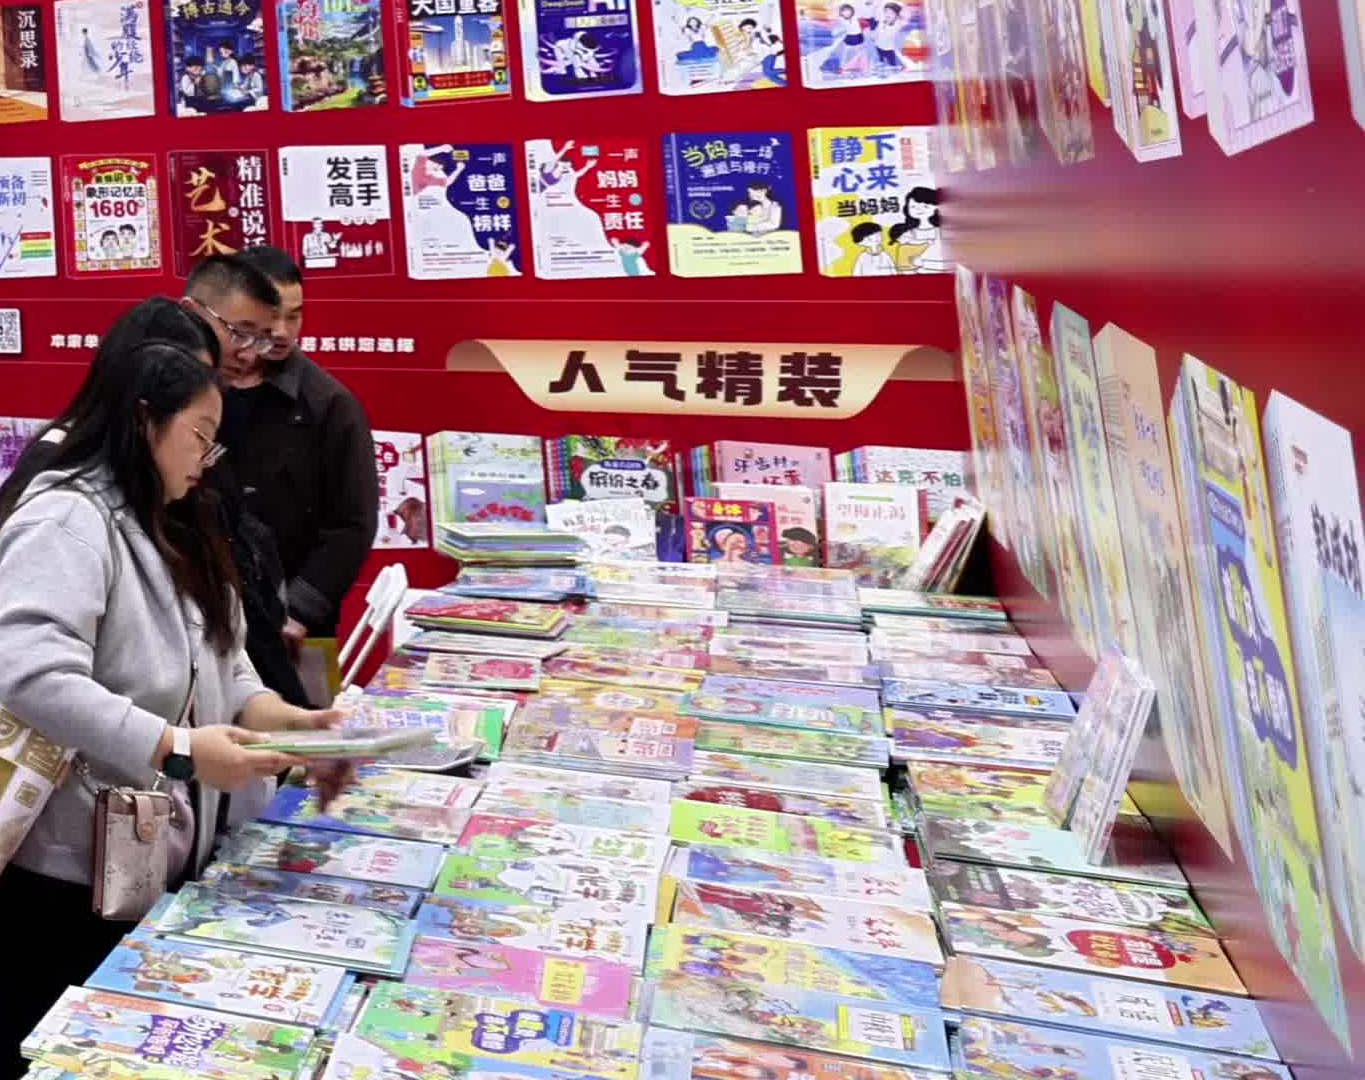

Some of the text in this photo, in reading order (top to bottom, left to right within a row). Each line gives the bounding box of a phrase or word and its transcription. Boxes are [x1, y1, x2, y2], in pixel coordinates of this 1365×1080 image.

[17, 10, 39, 69] 沉思录
[609, 148, 639, 163] 一声
[829, 133, 897, 164] 静下
[478, 152, 507, 167] 一声
[467, 172, 508, 193] 爸爸
[596, 170, 640, 189] 妈妈
[831, 165, 899, 193] 心来
[89, 198, 139, 219] 1680
[461, 195, 491, 212] 一生
[590, 193, 622, 209] 一生
[836, 197, 900, 218] 当妈妈
[472, 214, 512, 233] 榜样
[603, 212, 645, 231] 责任
[548, 350, 844, 408] 人气精装
